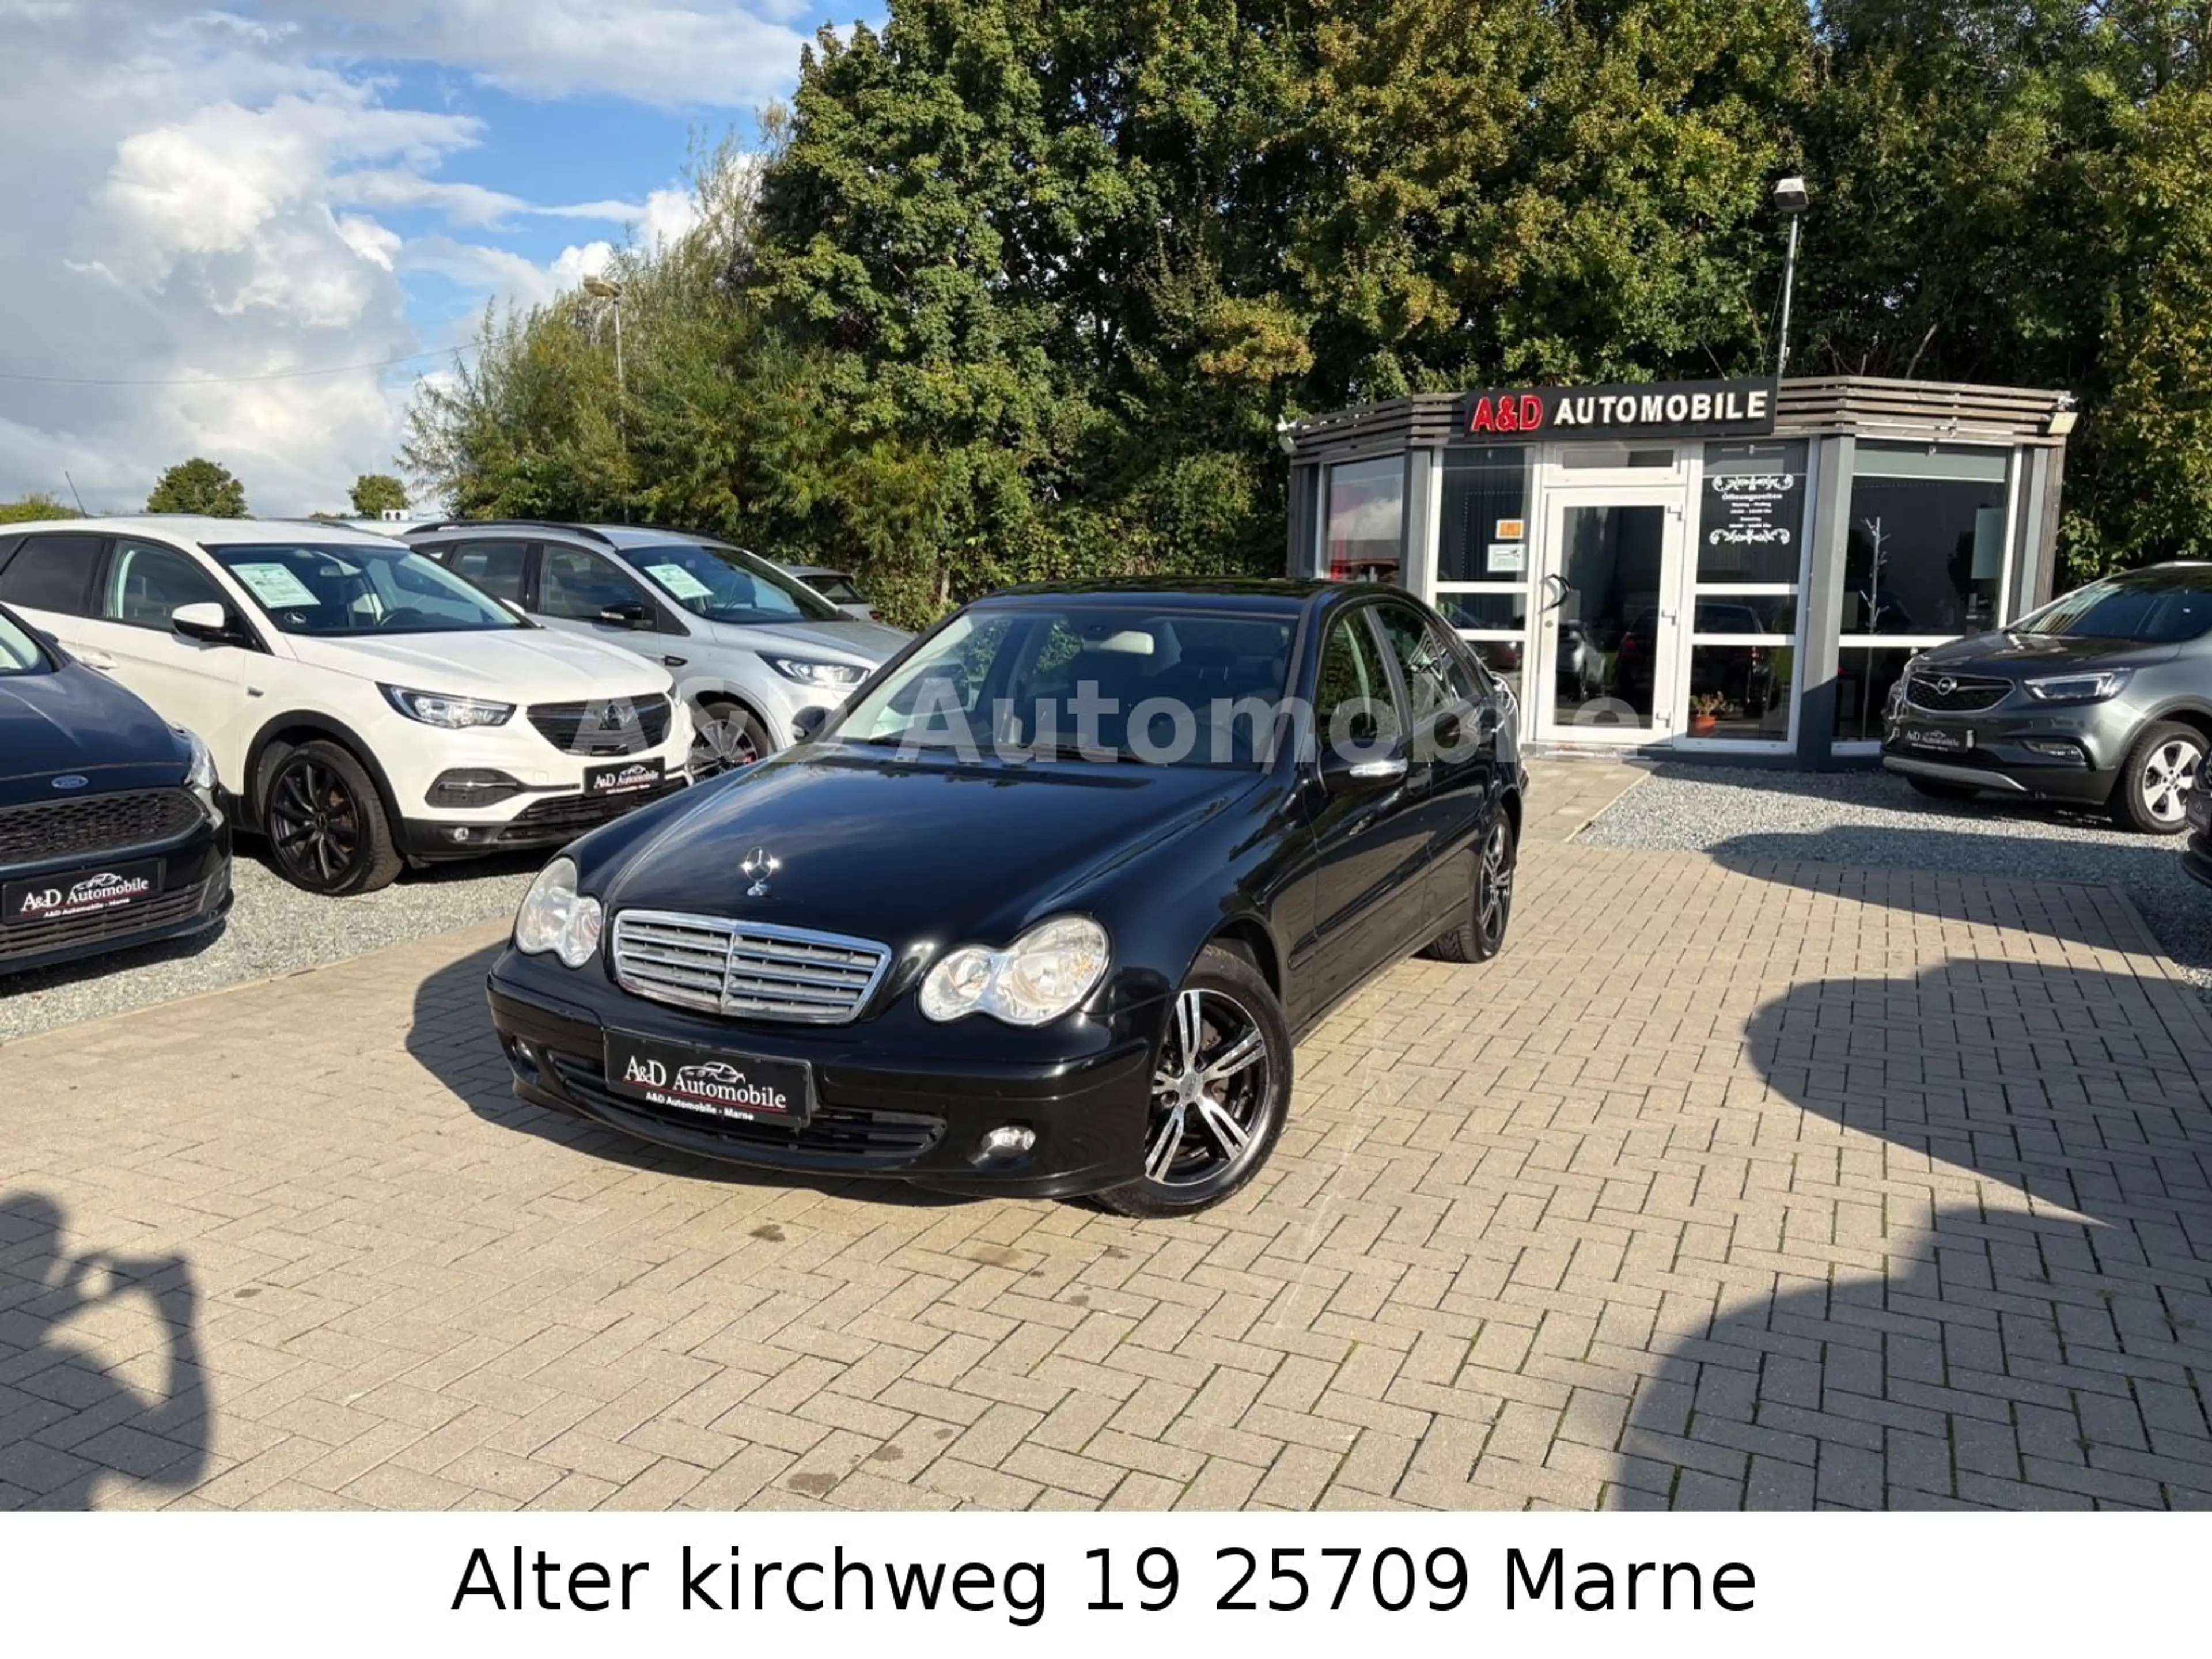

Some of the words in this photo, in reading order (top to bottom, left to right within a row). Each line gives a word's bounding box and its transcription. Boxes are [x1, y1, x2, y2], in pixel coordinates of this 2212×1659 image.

[1470, 395, 1543, 431] A&D
[1554, 390, 1769, 425] AUTOMOBILE
[21, 889, 62, 912] A&D
[66, 877, 149, 905] Automobile
[625, 1055, 666, 1087] A&D
[673, 1070, 786, 1108] Automobile
[646, 1092, 665, 1104] A&D
[666, 1096, 717, 1115] Automobile
[724, 1108, 755, 1121] Marne
